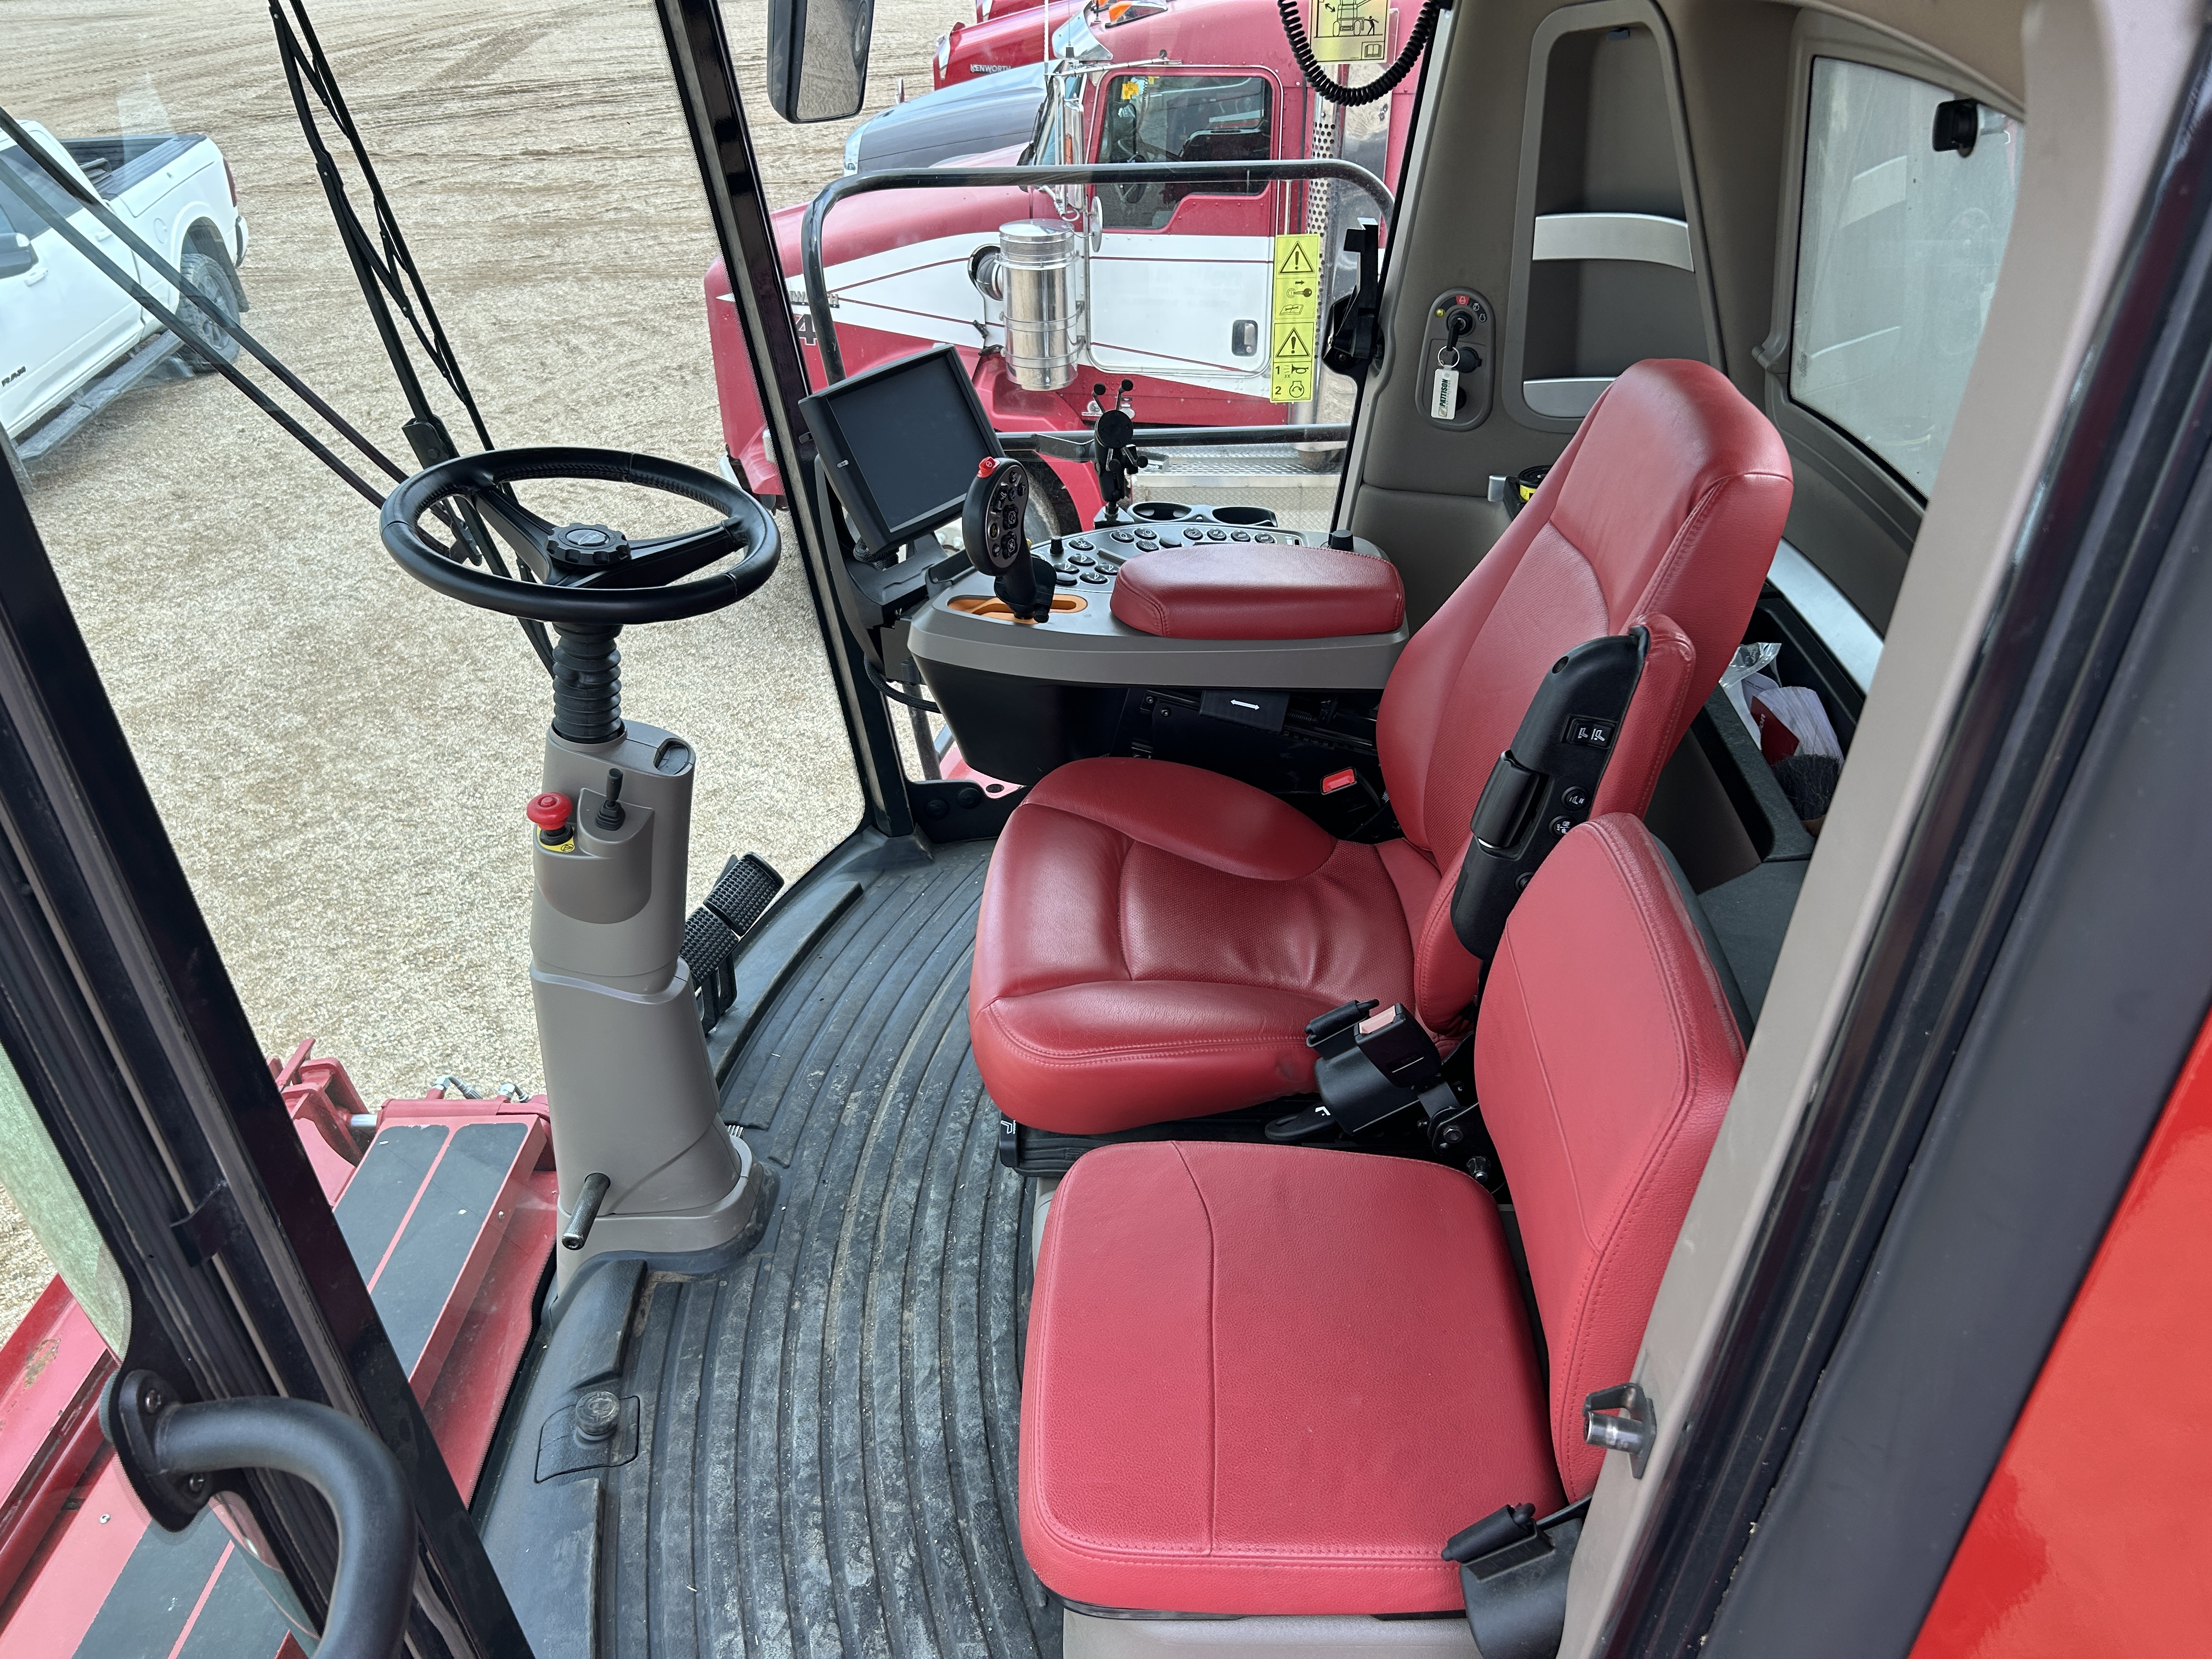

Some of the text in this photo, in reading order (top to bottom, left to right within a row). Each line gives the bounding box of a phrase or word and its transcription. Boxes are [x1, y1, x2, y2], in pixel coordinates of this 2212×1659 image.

[2, 366, 26, 387] RAM
[1275, 365, 1280, 375] 1
[1275, 386, 1282, 395] 2
[1440, 379, 1448, 407] PATTISON
